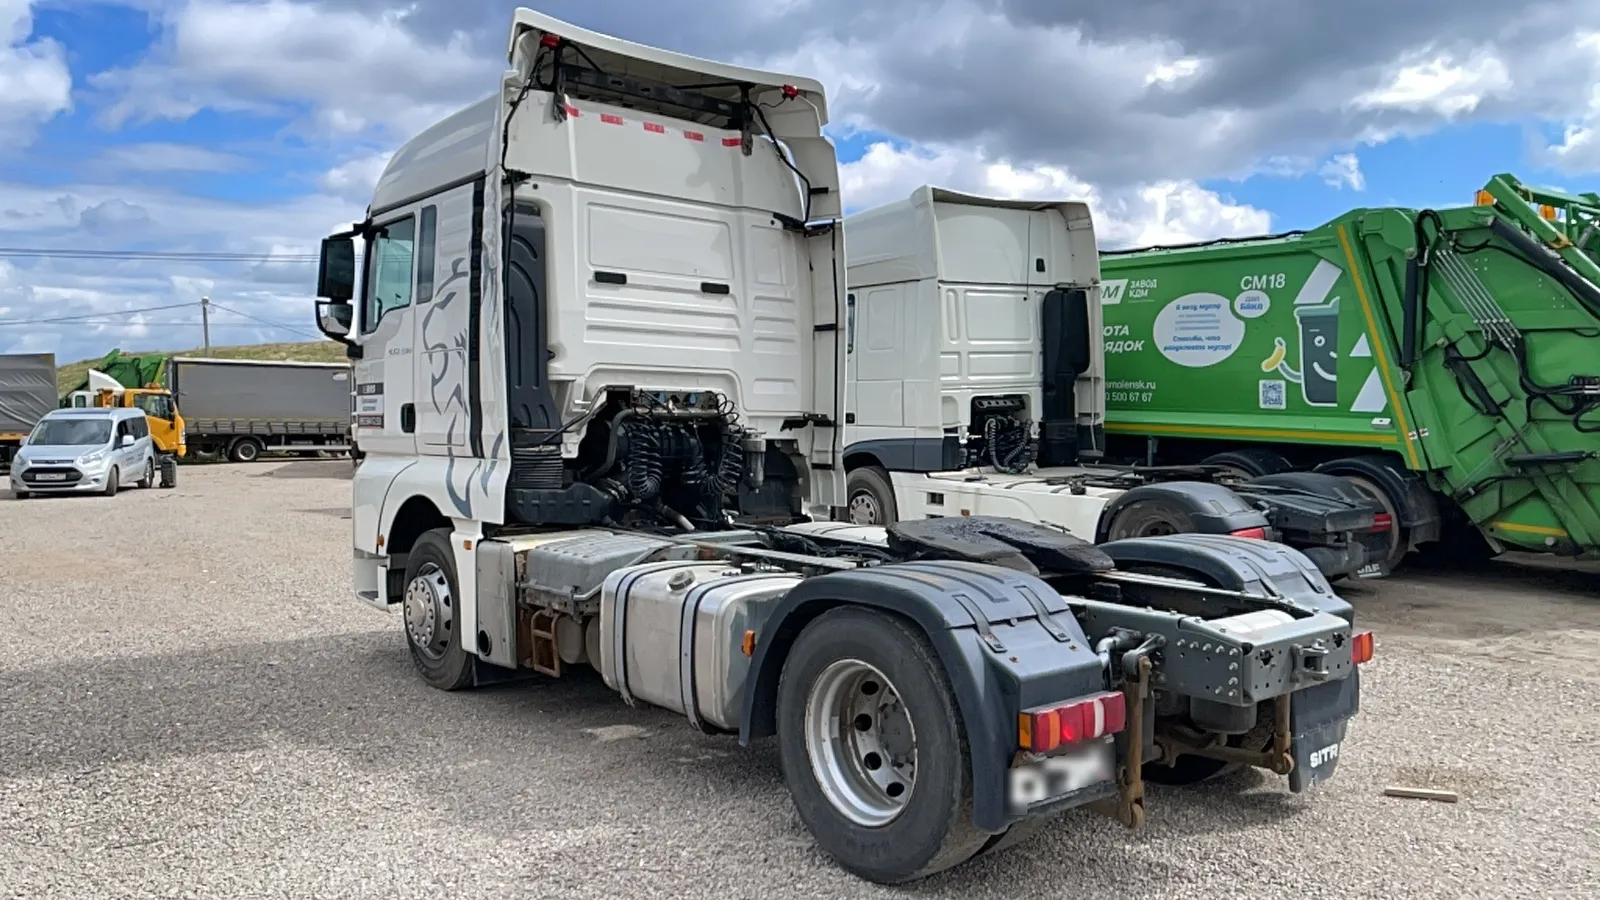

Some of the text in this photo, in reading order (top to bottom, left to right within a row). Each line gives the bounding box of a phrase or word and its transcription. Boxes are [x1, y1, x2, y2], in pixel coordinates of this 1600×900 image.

[1130, 279, 1157, 289] ЗАВОД
[1128, 289, 1149, 298] КДМ
[1199, 303, 1221, 311] мусор
[1112, 391, 1127, 402] 500
[1129, 391, 1140, 403] 67
[1142, 392, 1153, 403] 67
